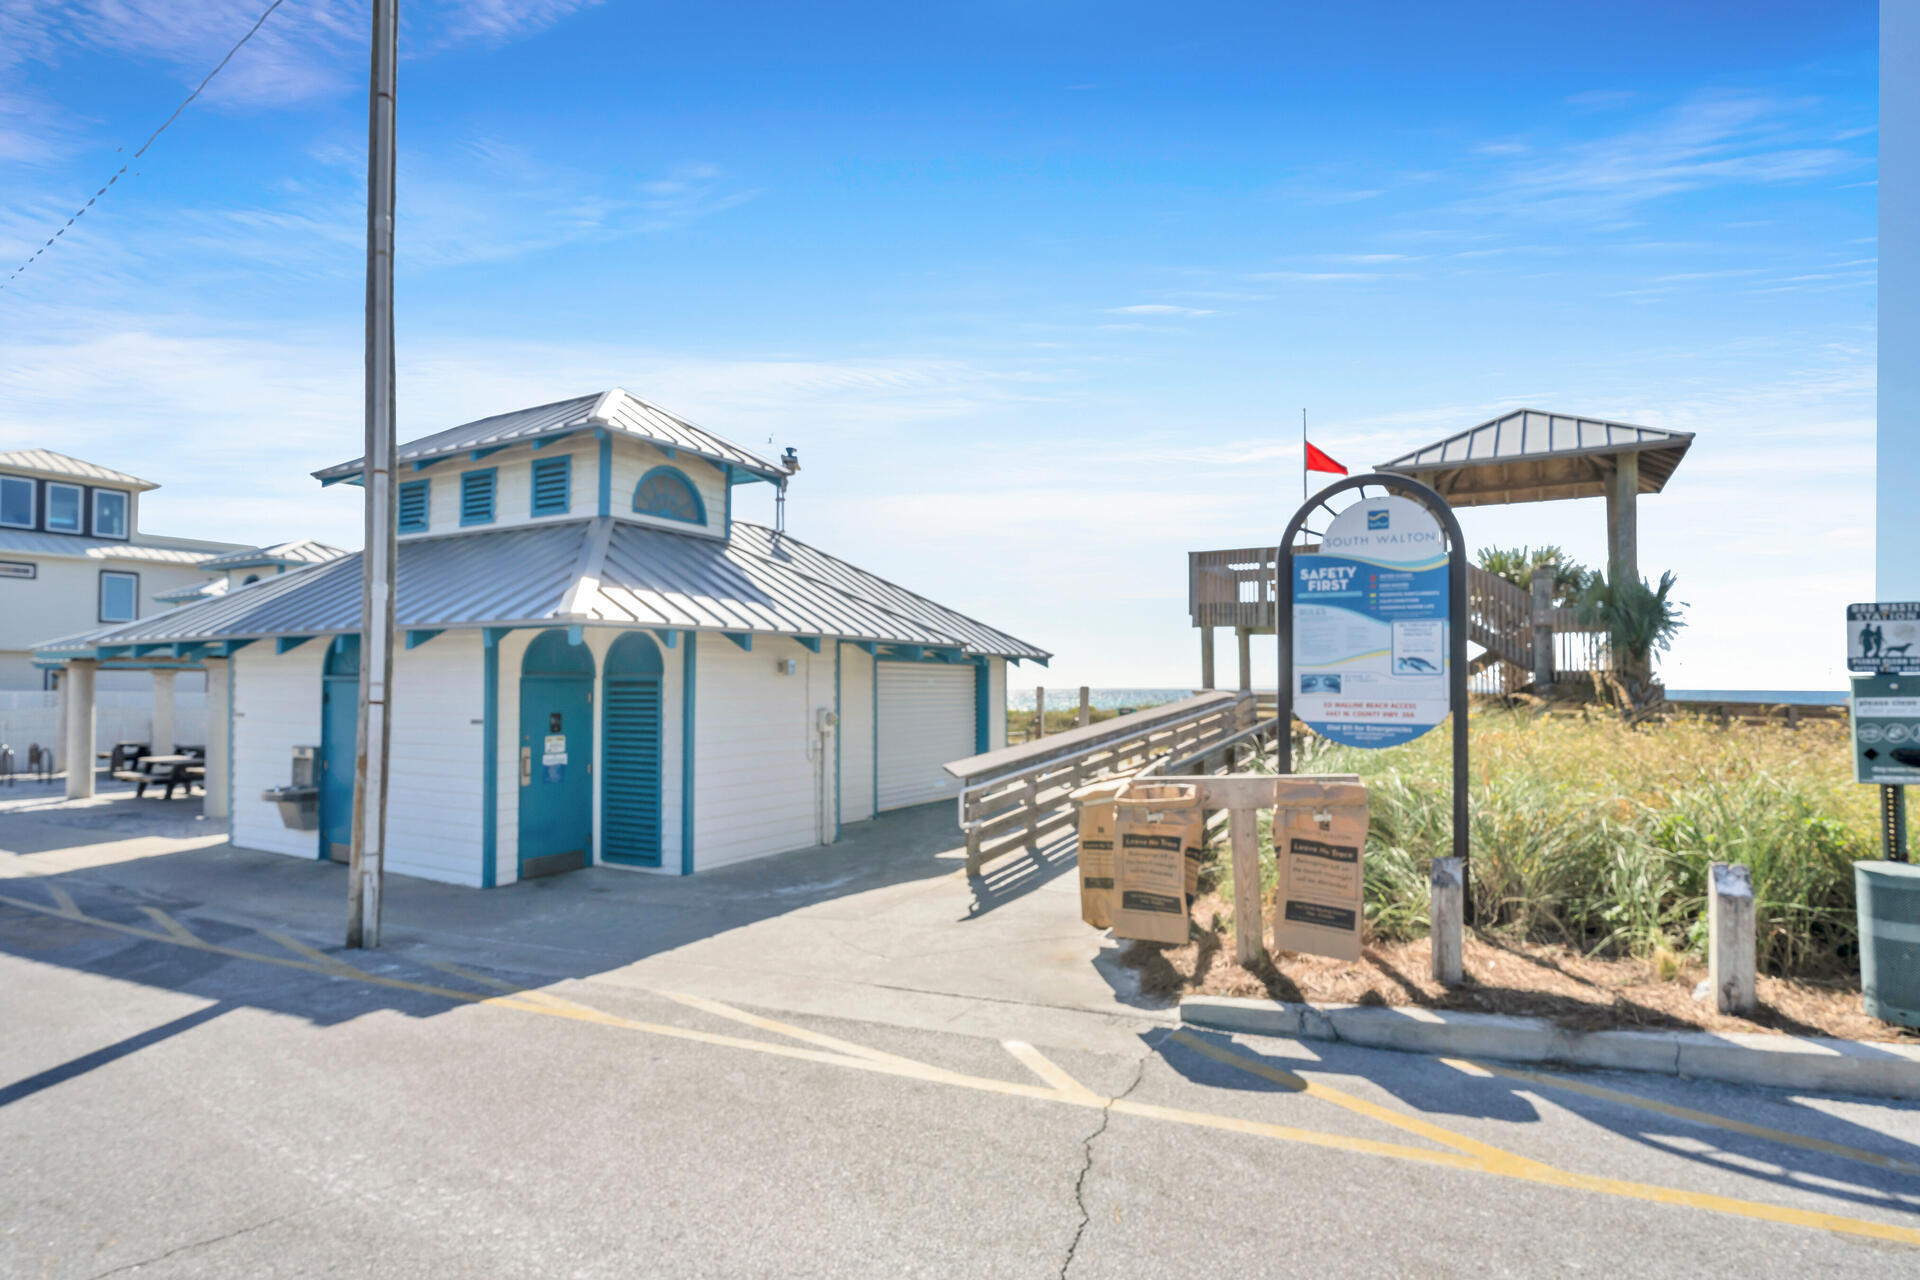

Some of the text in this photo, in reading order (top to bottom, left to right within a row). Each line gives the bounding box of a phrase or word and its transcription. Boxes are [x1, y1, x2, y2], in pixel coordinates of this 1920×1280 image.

[1325, 531, 1436, 548] SOUTH WALTON
[1300, 566, 1357, 581] SAFETY
[1308, 578, 1350, 592] FIRST
[1856, 612, 1917, 621] STATION
[1126, 837, 1147, 845] Leave
[1294, 841, 1354, 858] Leave No Trace
